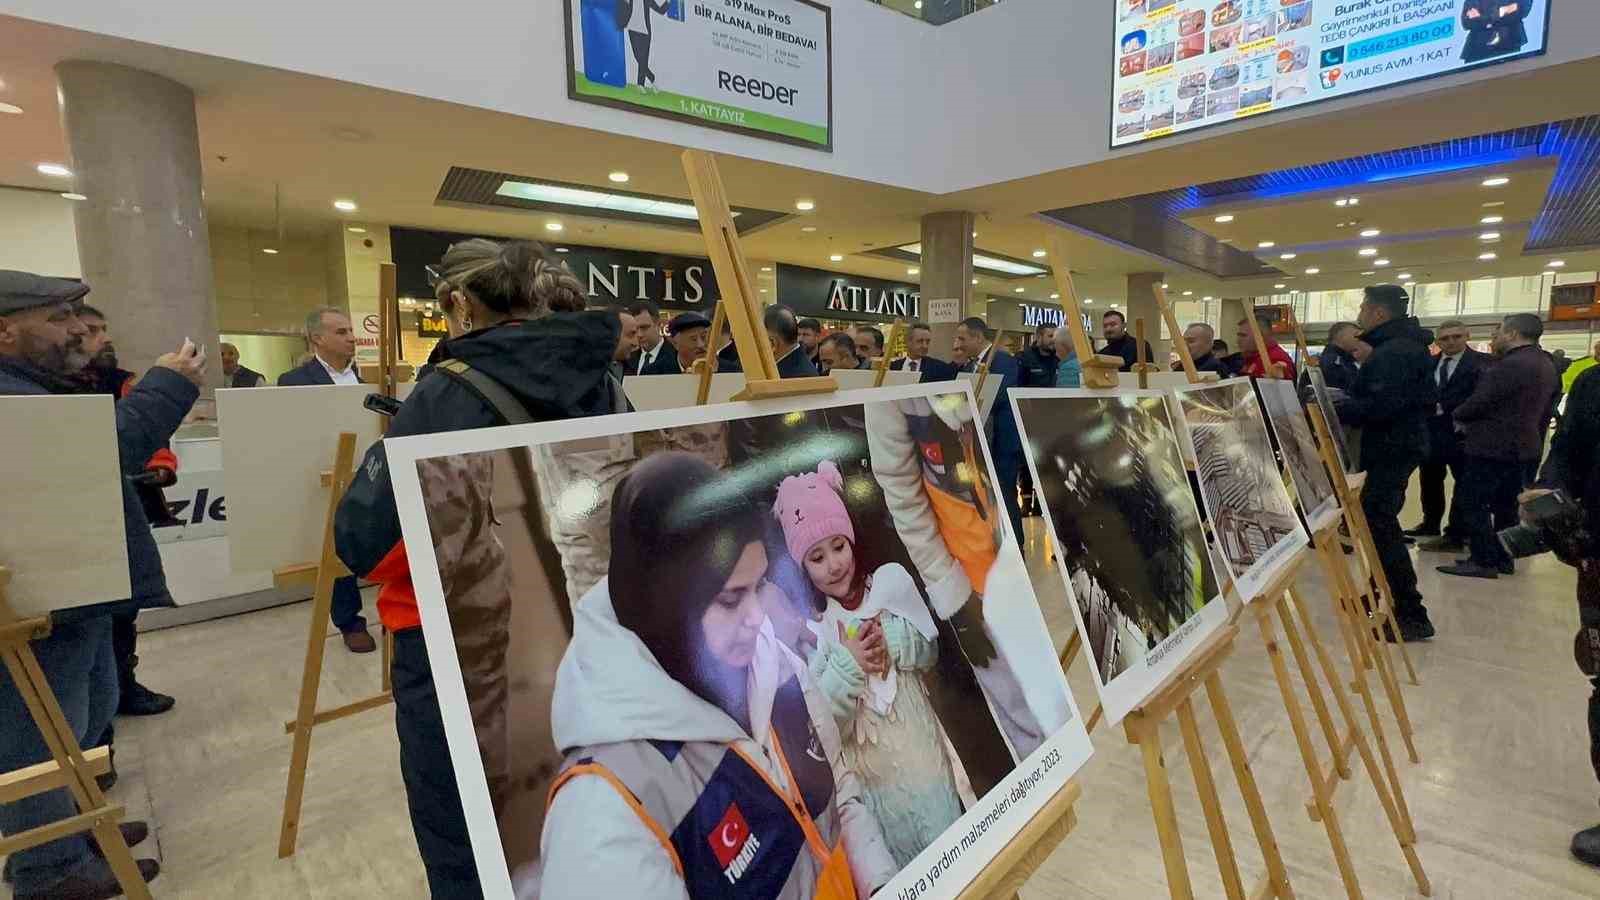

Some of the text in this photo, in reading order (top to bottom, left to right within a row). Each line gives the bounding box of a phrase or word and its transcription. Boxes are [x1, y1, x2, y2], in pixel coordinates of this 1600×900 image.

[745, 2, 766, 18] Max
[694, 4, 712, 18] BİR
[714, 12, 755, 34] ALANA,
[757, 23, 774, 37] BİR
[776, 30, 817, 50] BEDAVA!
[1344, 65, 1383, 80] YUNUS
[1385, 57, 1413, 71] AVM
[691, 102, 746, 123] KATTAYIZ
[927, 844, 962, 887] yardım
[961, 794, 1010, 851] malzemeleri
